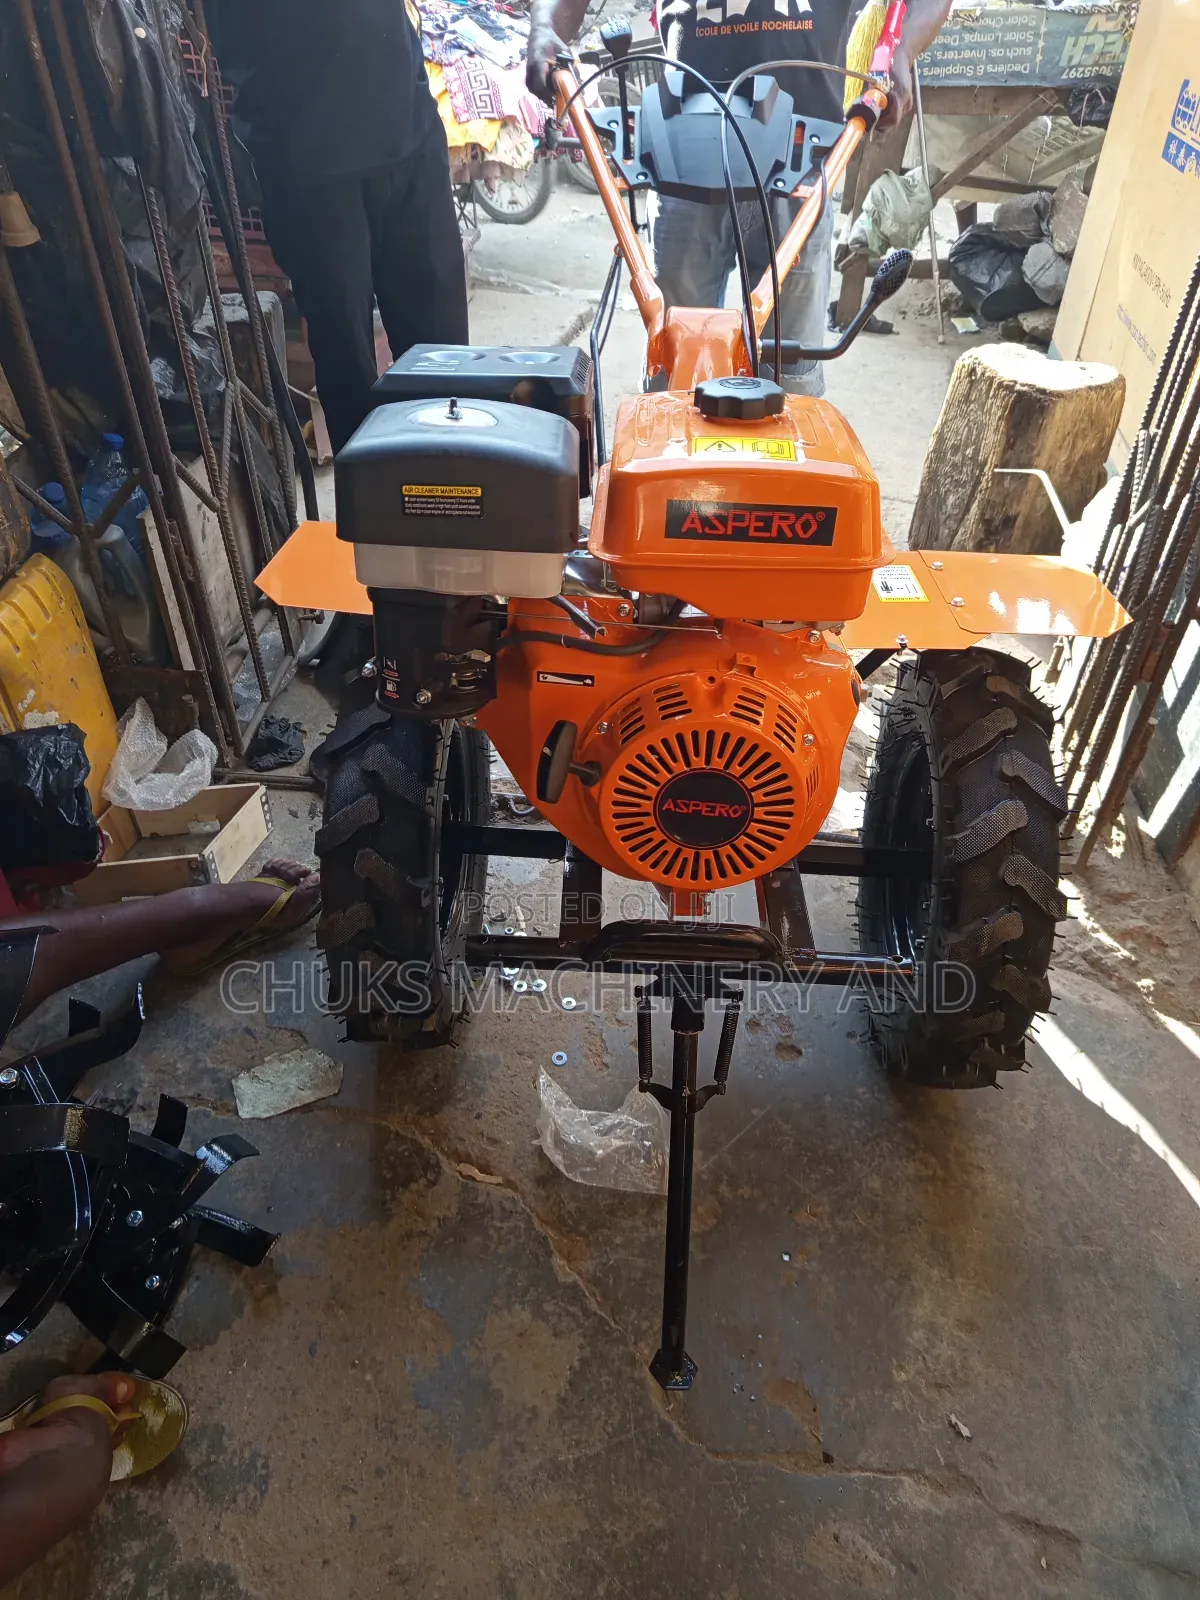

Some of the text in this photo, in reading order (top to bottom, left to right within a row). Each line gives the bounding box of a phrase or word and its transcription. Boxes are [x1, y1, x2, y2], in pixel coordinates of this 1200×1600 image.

[1007, 15, 1037, 26] Solar
[721, 25, 732, 35] DE
[733, 22, 760, 33] VOILE
[762, 19, 814, 31] ROCHELAISE
[934, 50, 986, 60] Inverters,
[988, 48, 1005, 57] as:
[1006, 47, 1033, 59] such
[923, 63, 1030, 78] Dealers & Suppliers
[404, 486, 414, 494] AIR
[440, 487, 479, 495] MAINTENANCE
